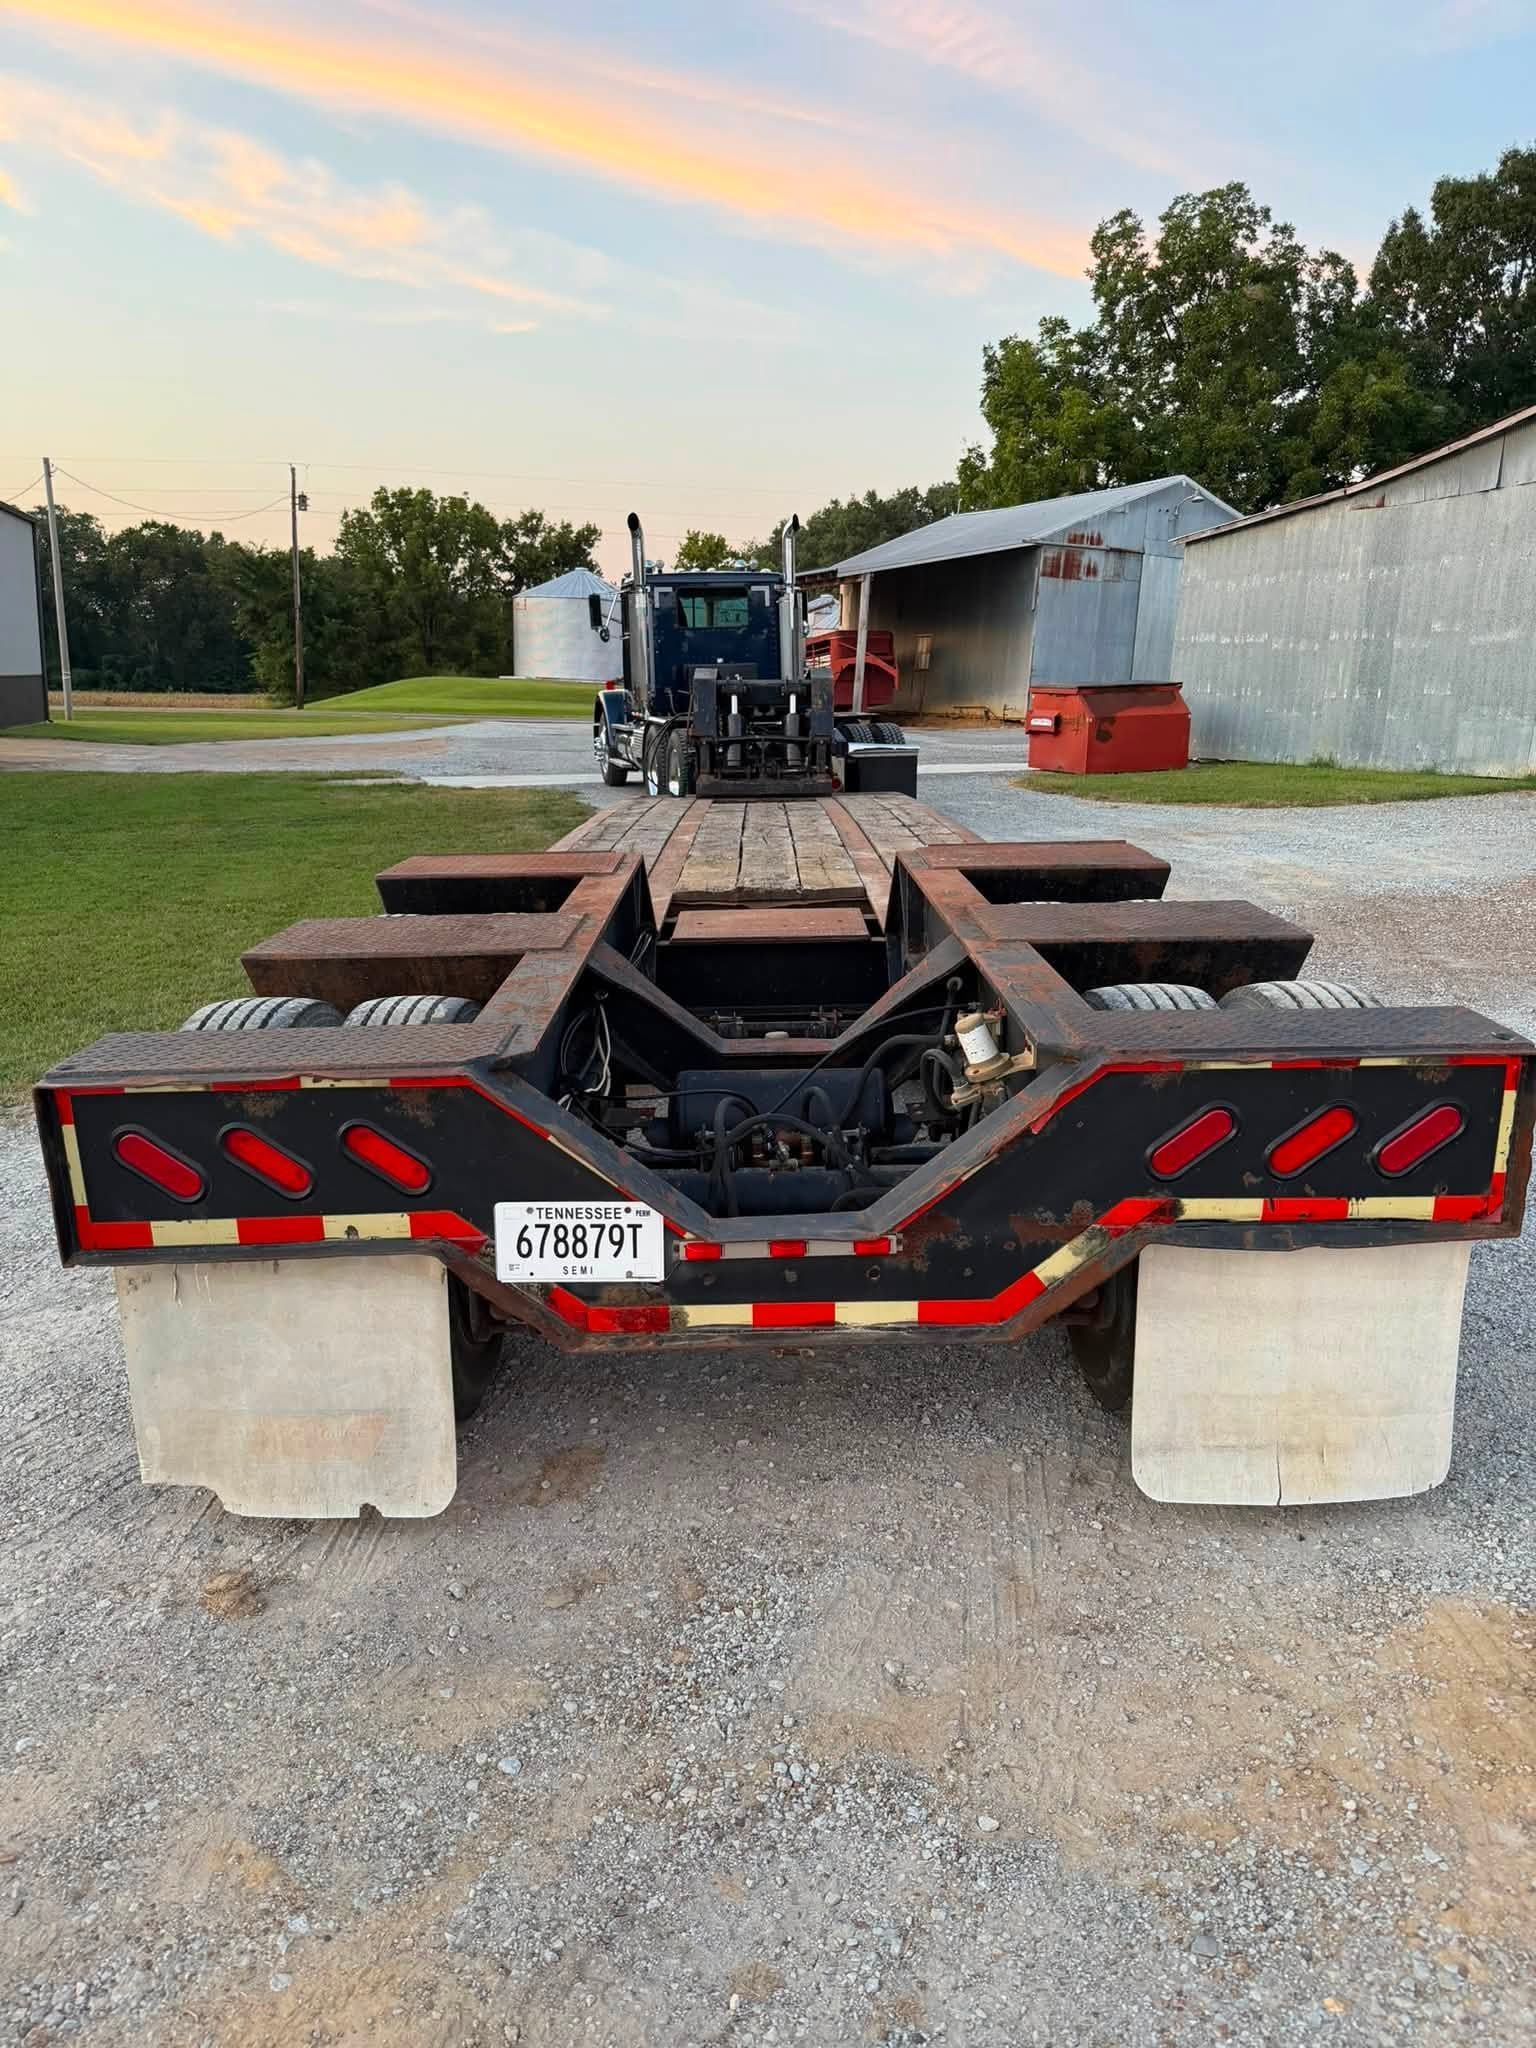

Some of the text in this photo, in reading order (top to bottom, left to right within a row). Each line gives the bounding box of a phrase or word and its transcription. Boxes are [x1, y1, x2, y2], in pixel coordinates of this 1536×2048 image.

[535, 1207, 622, 1220] TENNESSEE
[516, 1223, 643, 1259] 678879T
[562, 1265, 593, 1275] SEMI
